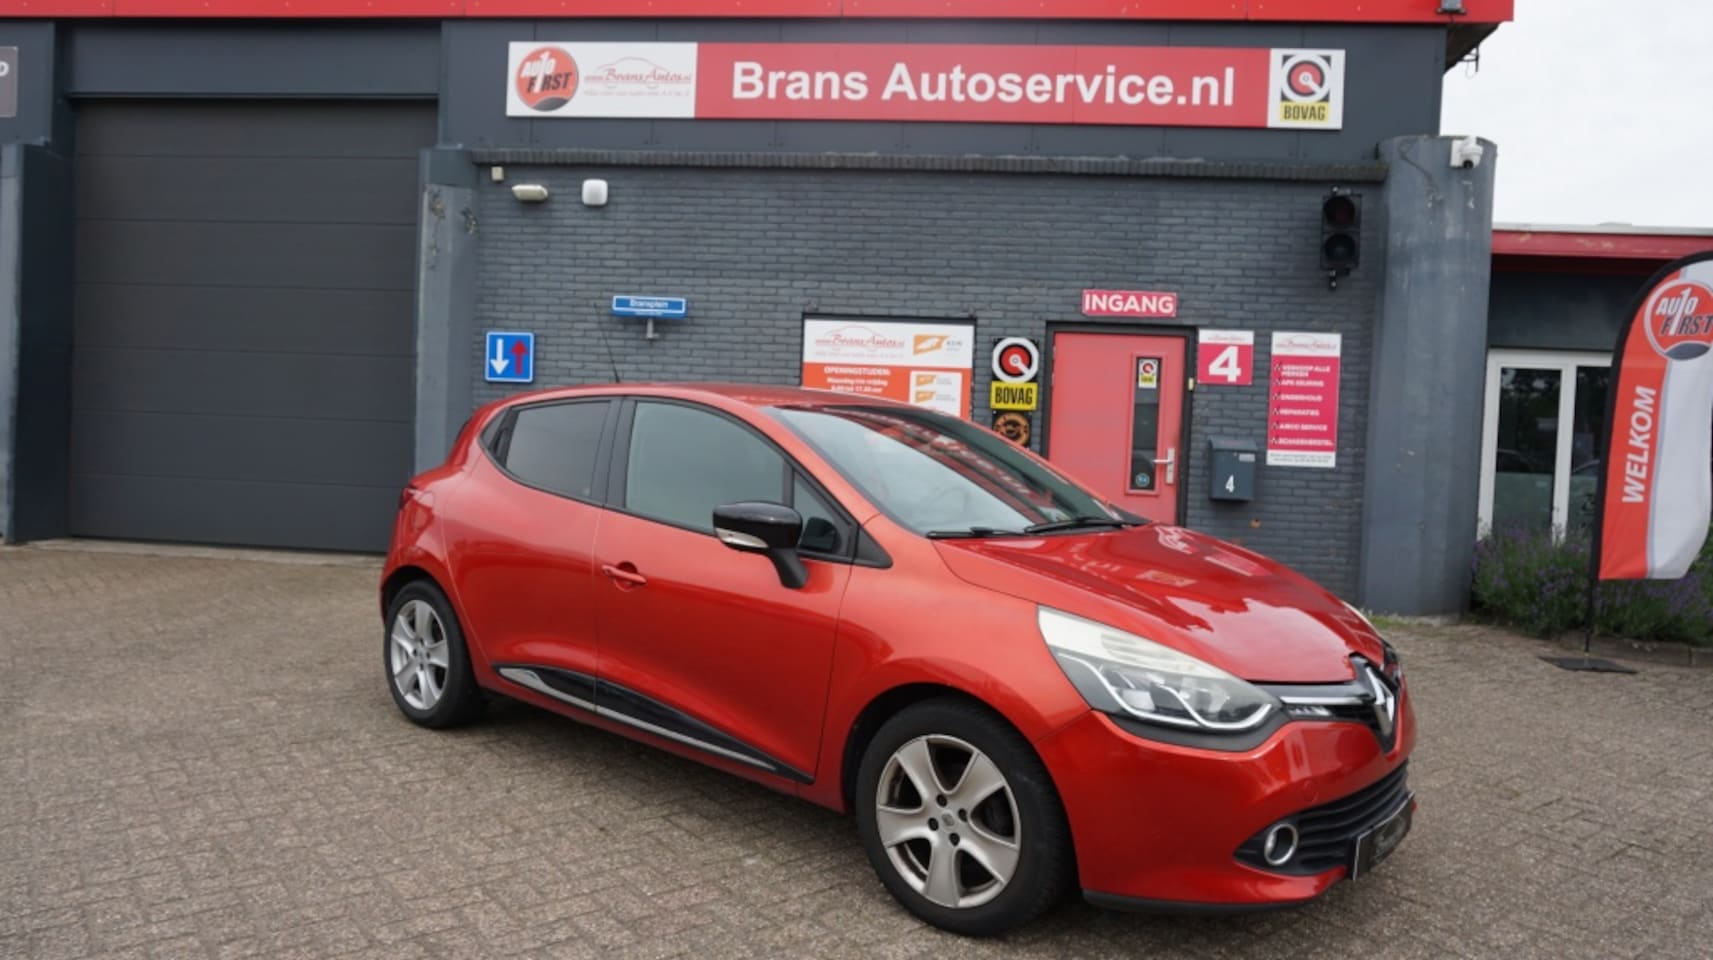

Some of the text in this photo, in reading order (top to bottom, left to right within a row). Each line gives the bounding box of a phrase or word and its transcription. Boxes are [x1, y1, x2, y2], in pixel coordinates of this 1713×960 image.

[527, 72, 572, 94] FIRST
[732, 61, 1235, 106] Brans Autoservice.nl
[1283, 105, 1326, 121] BOVAG
[1084, 294, 1175, 314] INGANG
[1208, 345, 1242, 383] 4
[995, 387, 1033, 405] BOVAG
[1622, 385, 1656, 503] WELKOM
[1225, 474, 1235, 492] 4
